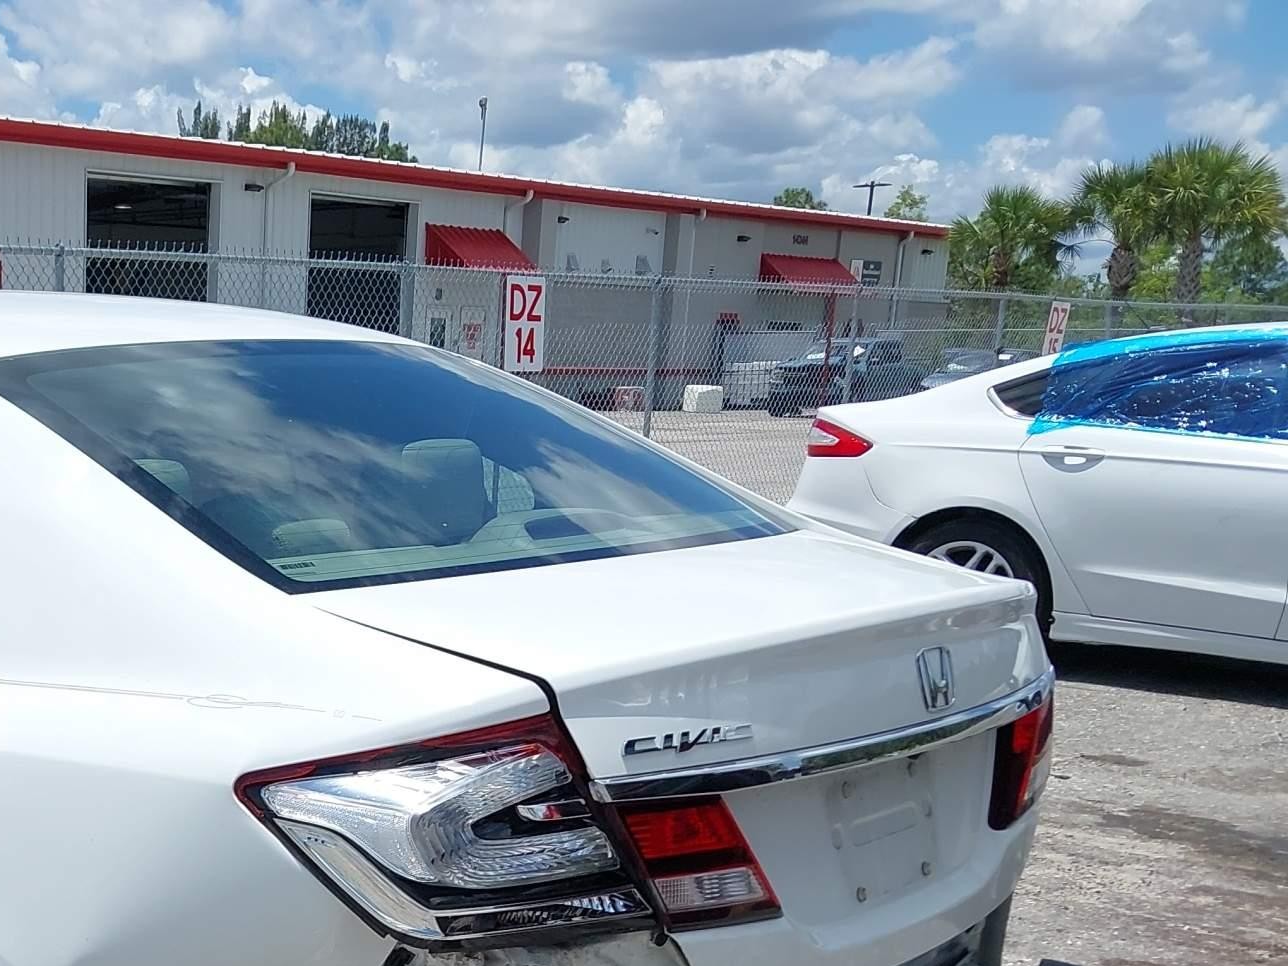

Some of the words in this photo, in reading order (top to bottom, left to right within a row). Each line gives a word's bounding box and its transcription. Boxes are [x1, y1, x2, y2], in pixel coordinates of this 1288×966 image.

[509, 283, 543, 322] DZ
[1048, 306, 1068, 334] DZ
[515, 327, 536, 364] 14
[622, 722, 754, 756] CIVIC
